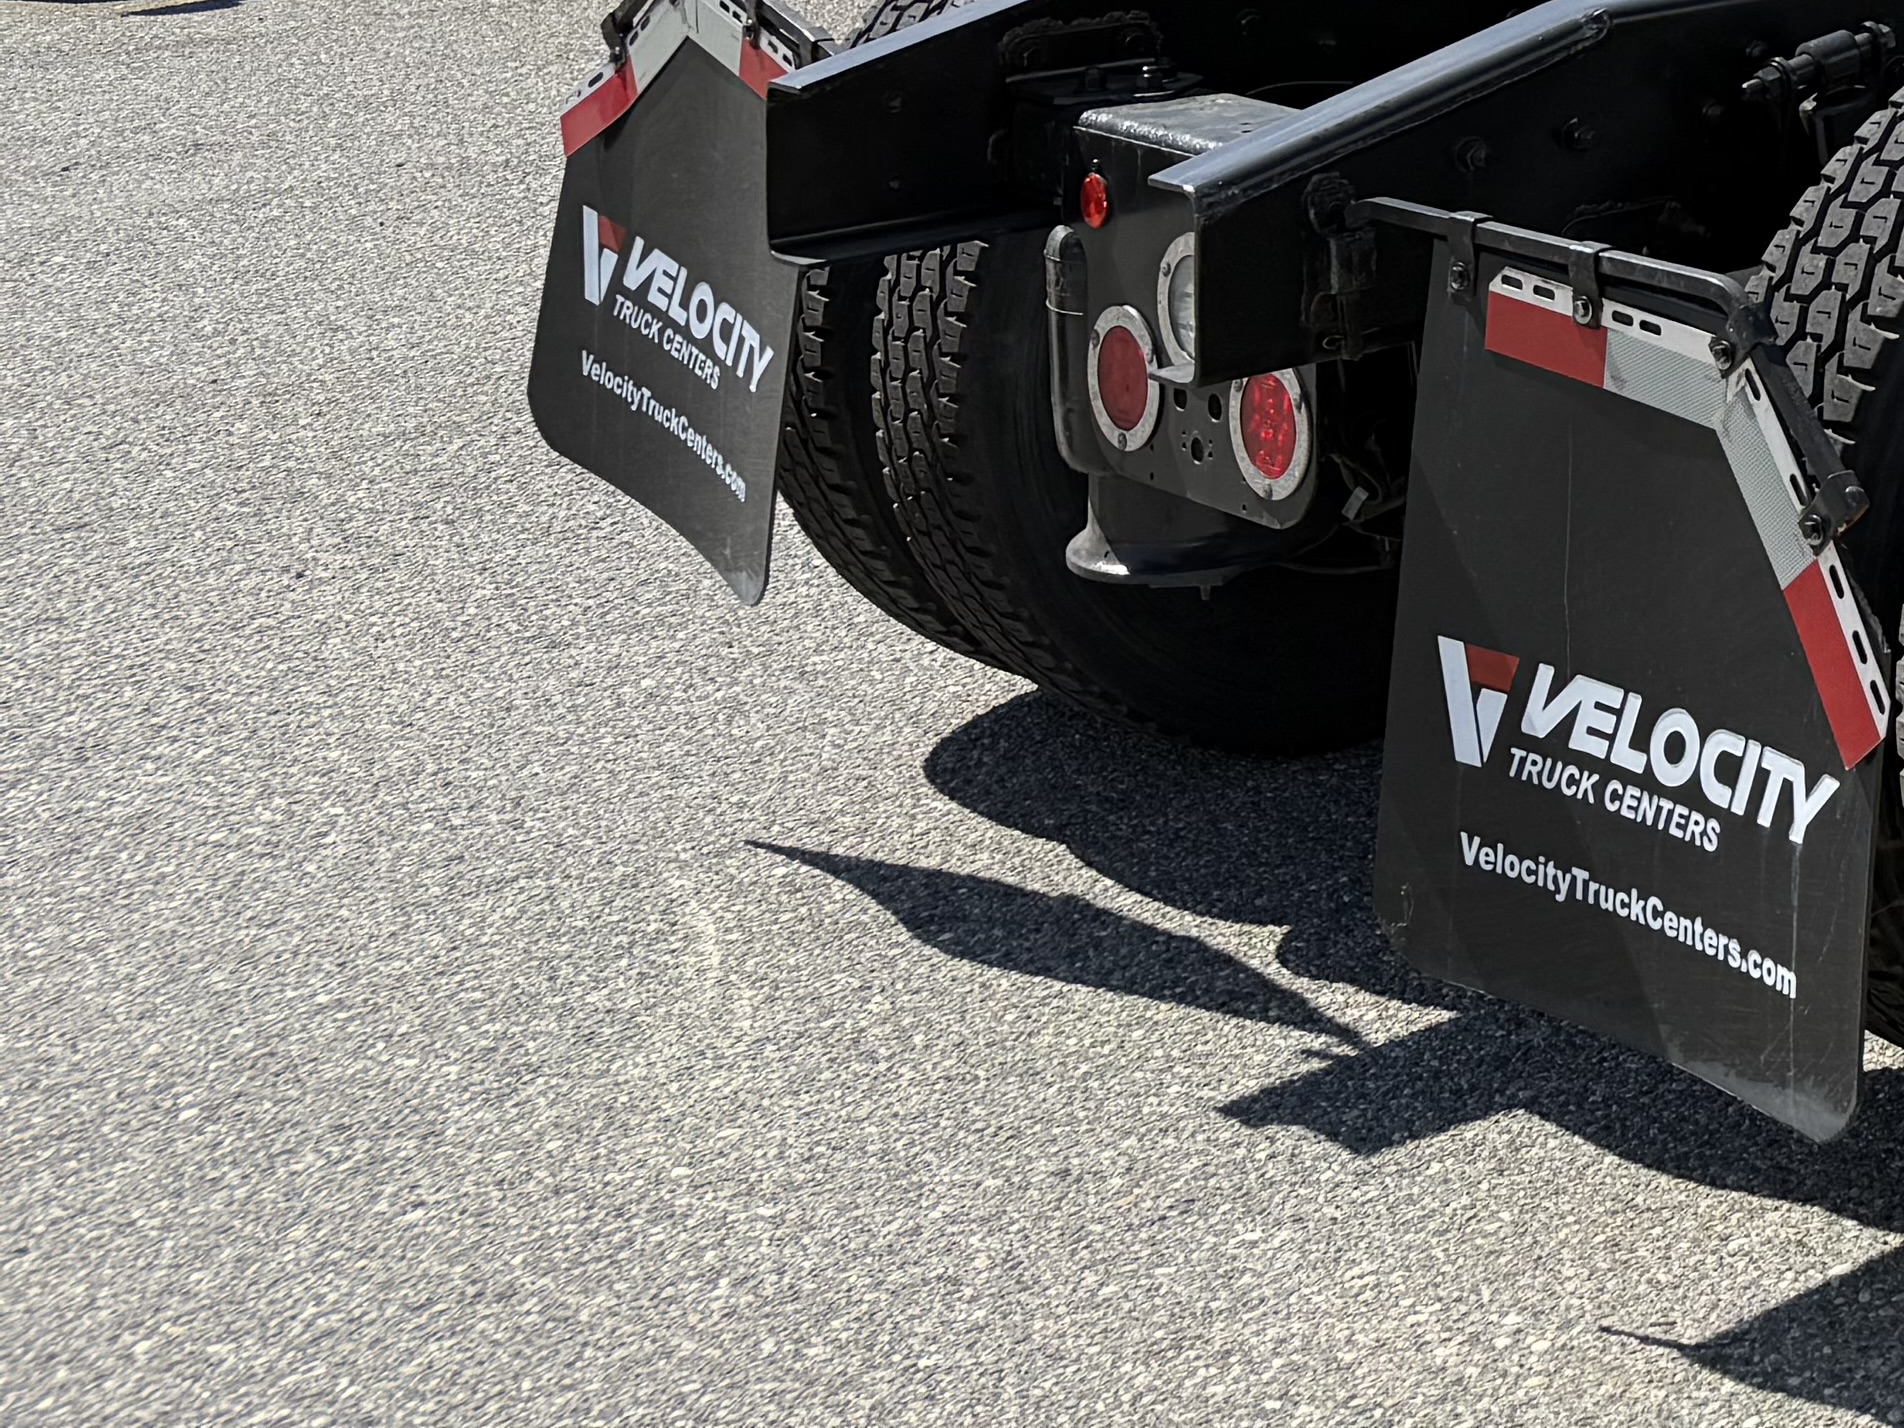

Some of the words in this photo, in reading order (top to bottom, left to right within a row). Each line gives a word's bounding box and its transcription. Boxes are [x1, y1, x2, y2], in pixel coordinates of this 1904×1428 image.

[612, 294, 663, 344] TRUCK
[662, 327, 721, 390] CENTERS
[622, 235, 775, 393] VELOCITY
[581, 349, 747, 503] VelocityTruckCenters.com
[1508, 746, 1600, 805] TRUCK
[1603, 778, 1722, 853] CENTERS
[1520, 662, 1841, 844] VELOCITY
[1459, 830, 1797, 1000] VelocityTruckCenters.com
